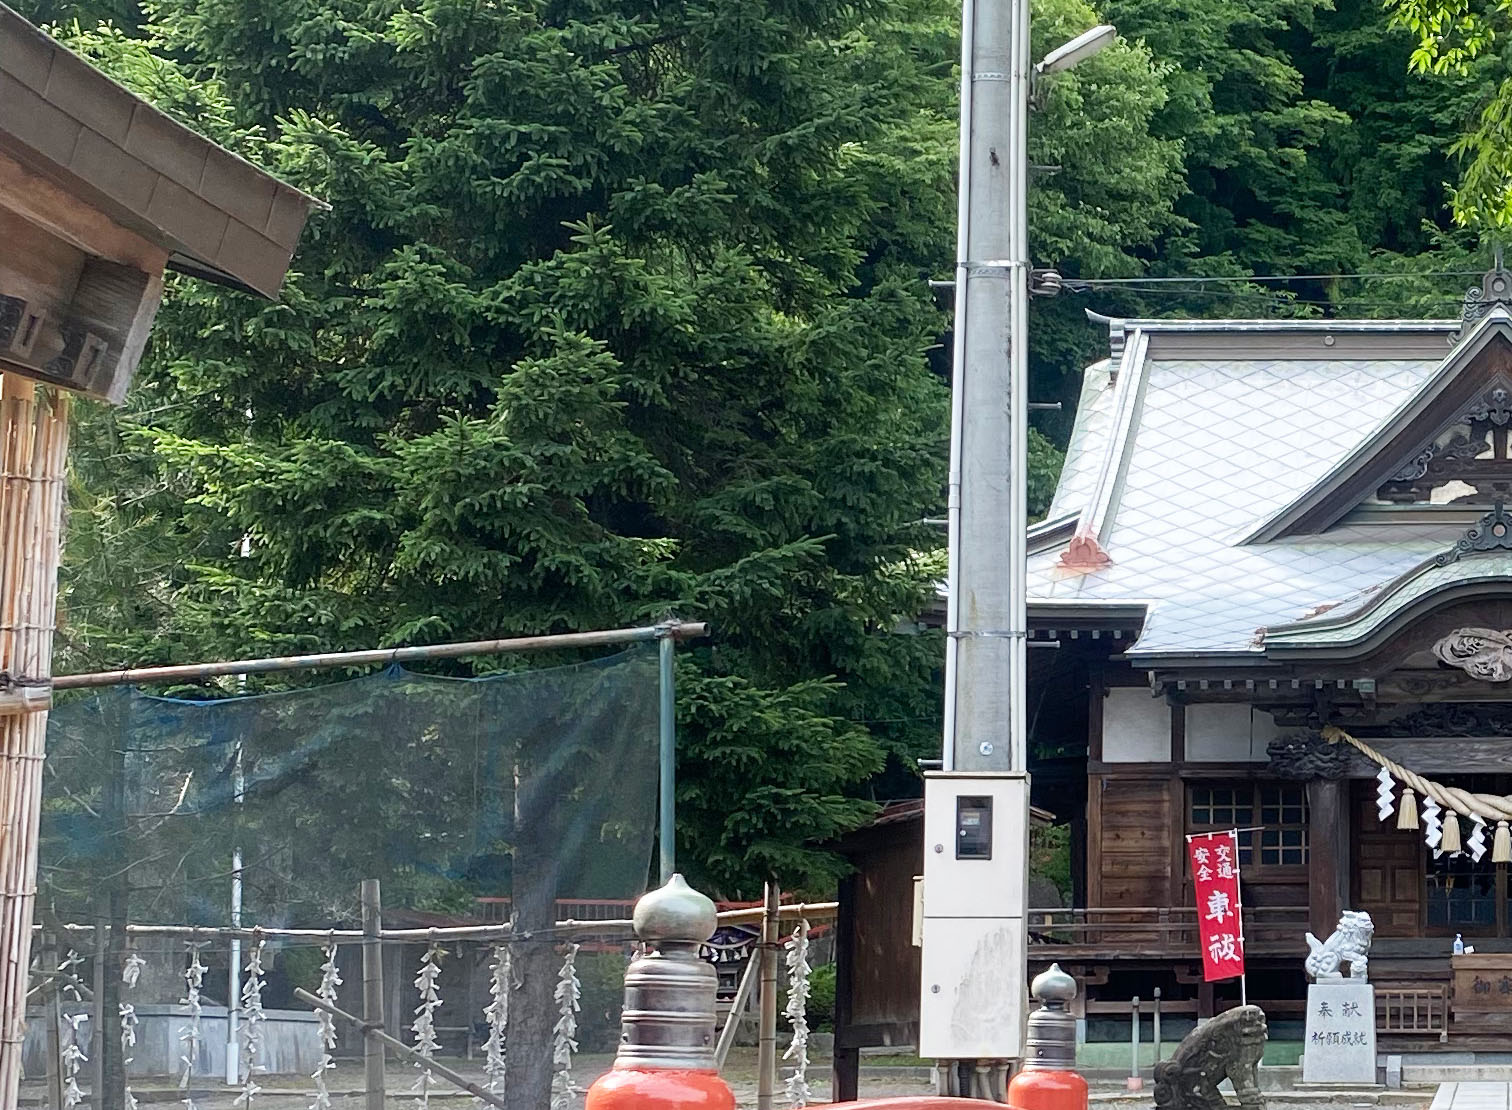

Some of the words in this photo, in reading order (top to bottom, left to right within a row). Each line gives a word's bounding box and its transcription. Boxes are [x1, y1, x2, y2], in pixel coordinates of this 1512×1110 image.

[1193, 846, 1213, 882] 安全
[1214, 844, 1234, 879] 交通
[1205, 889, 1241, 965] 車祓
[1311, 1029, 1368, 1047] 祈願成就
